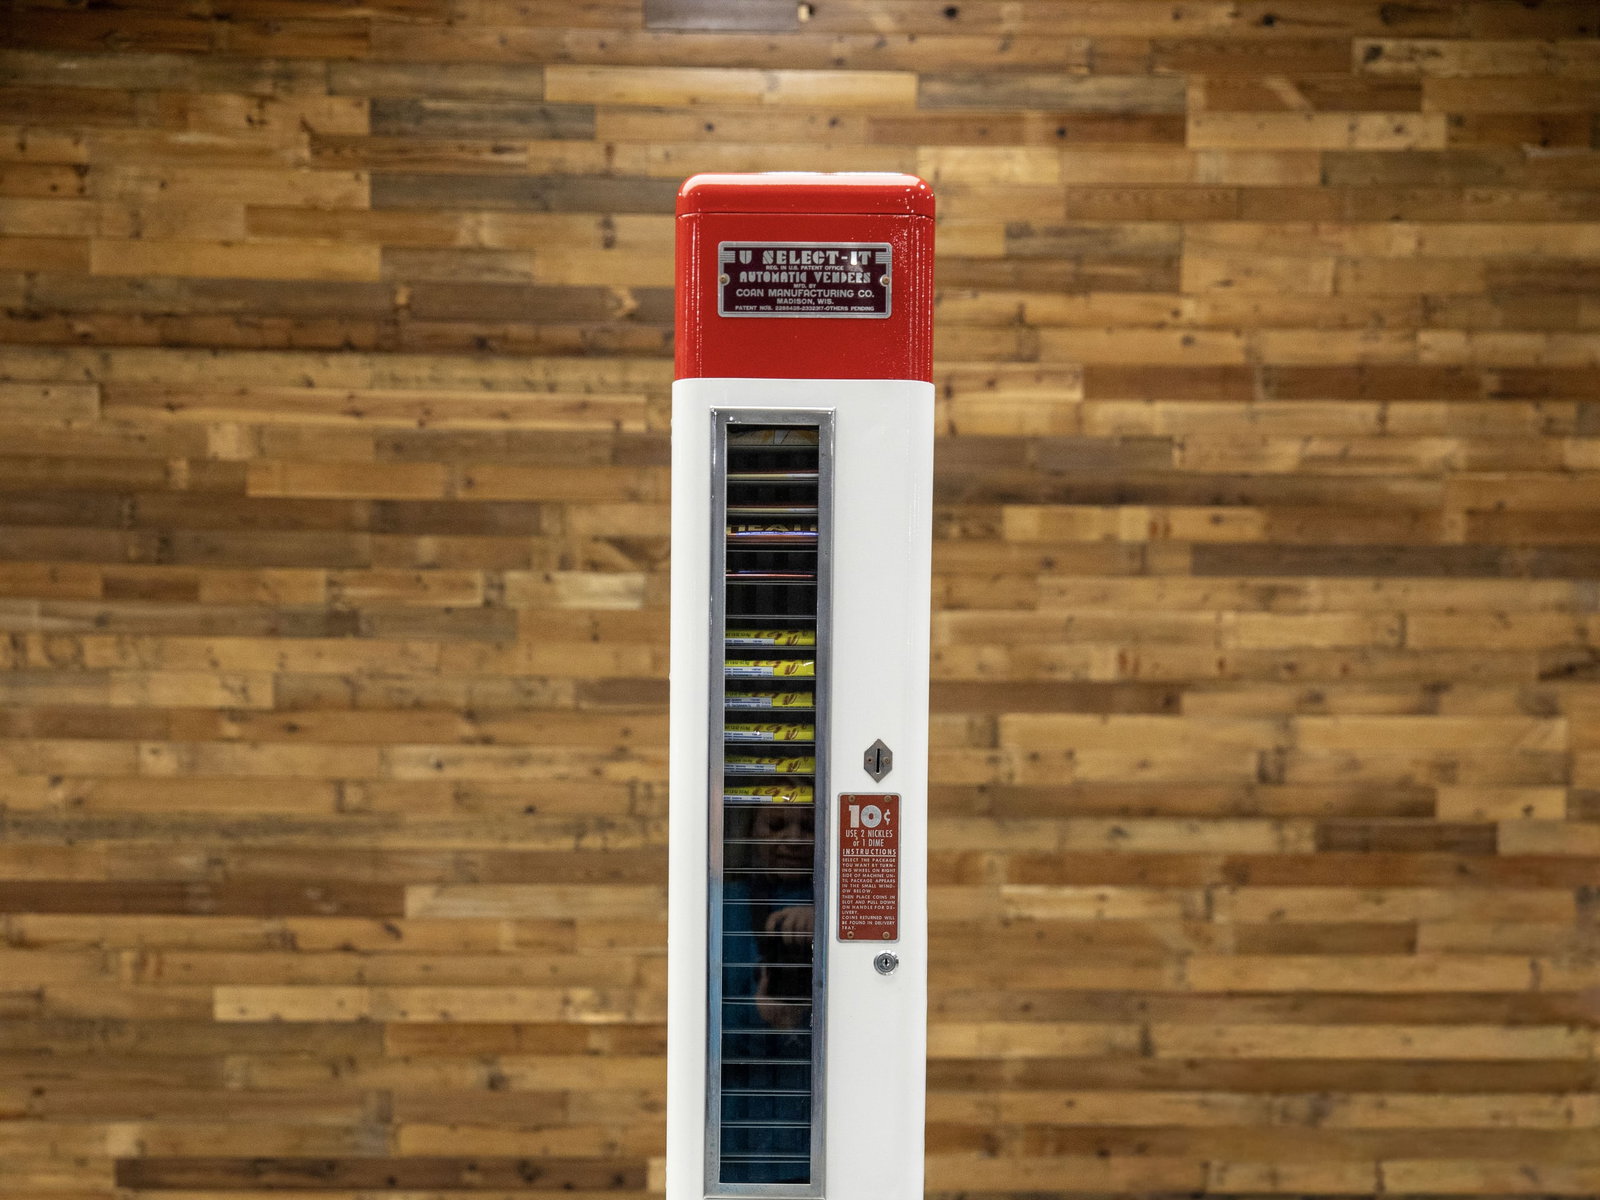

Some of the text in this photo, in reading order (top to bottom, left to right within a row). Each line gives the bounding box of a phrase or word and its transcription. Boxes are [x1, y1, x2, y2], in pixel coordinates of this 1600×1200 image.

[739, 250, 871, 265] U SELECT-IT
[740, 271, 871, 283] AUTOMATIC VENDERS
[736, 289, 874, 298] COAN MANUFACTURING CO.
